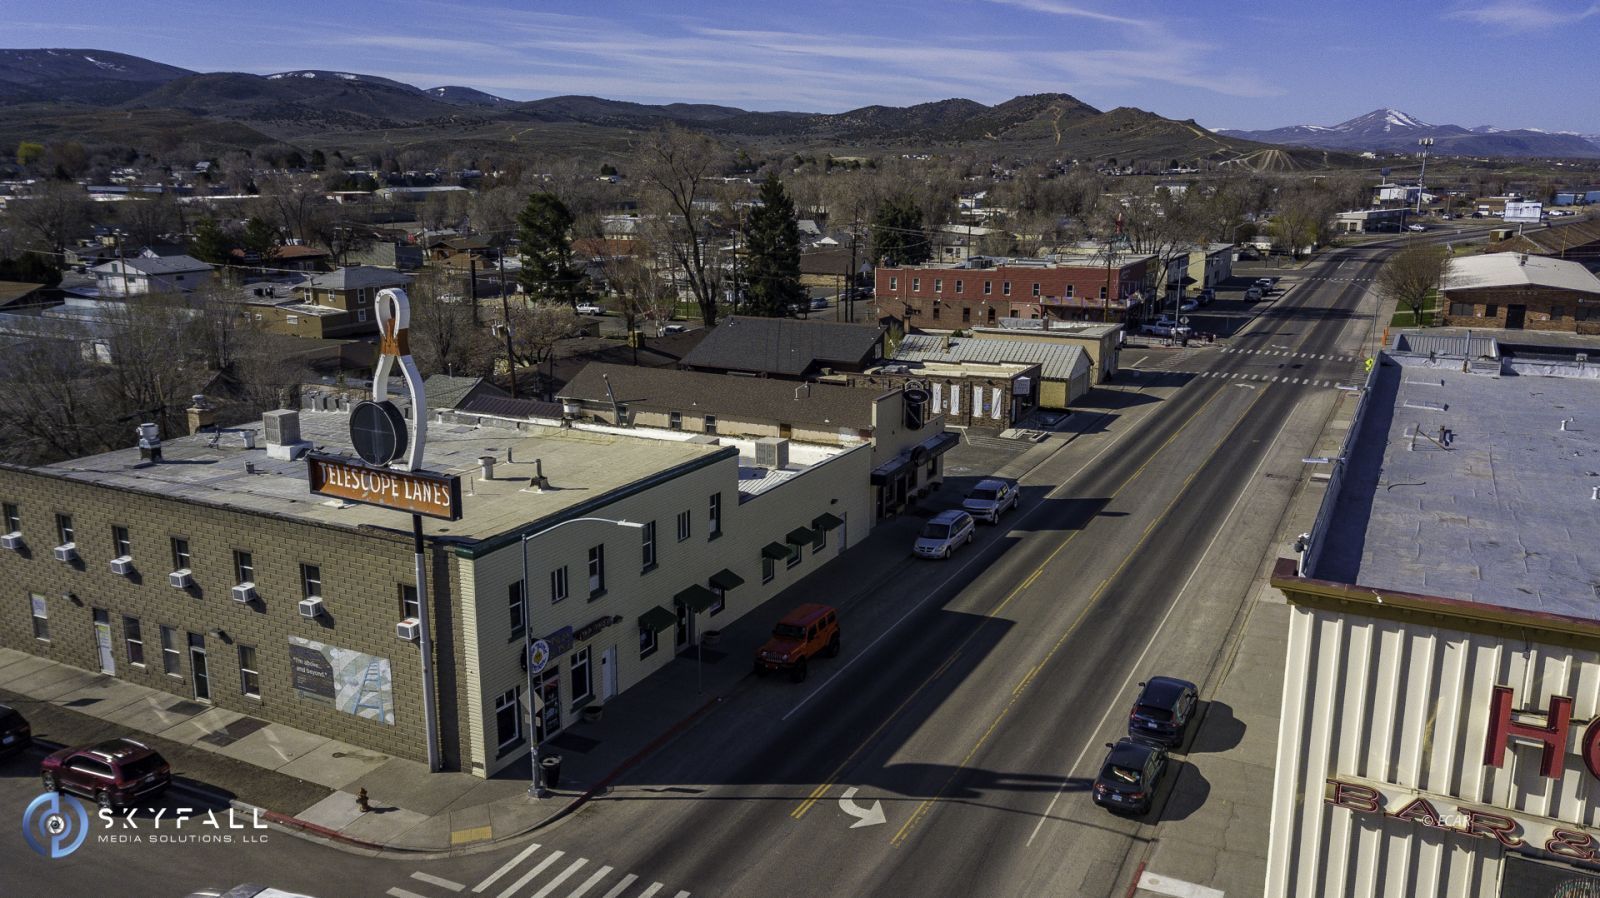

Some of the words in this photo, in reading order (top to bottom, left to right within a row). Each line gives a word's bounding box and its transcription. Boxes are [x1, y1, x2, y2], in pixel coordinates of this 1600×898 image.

[319, 461, 399, 497] TELESCOPE
[404, 477, 450, 507] LANES
[1483, 685, 1600, 782] H
[1324, 779, 1523, 848] BAR
[1545, 828, 1600, 863] &
